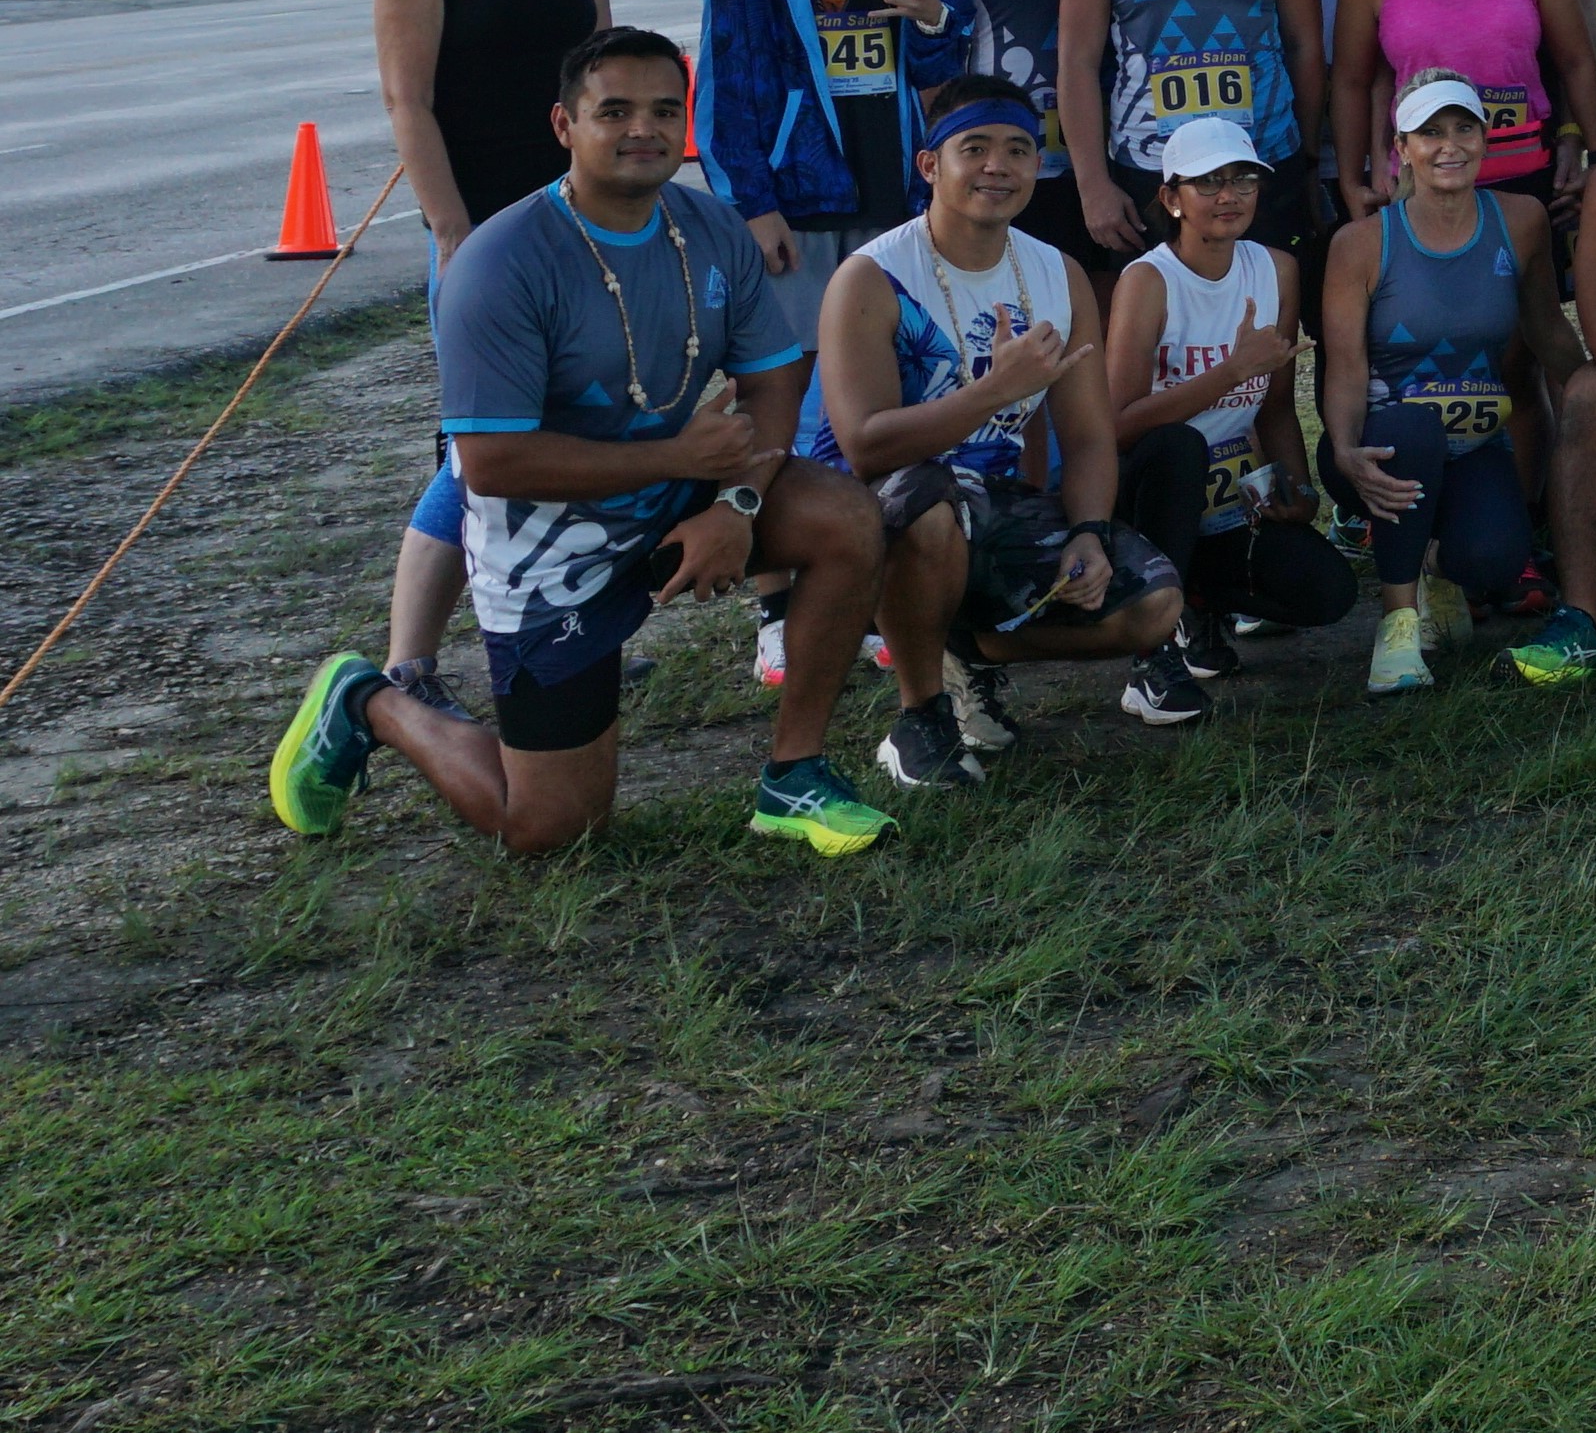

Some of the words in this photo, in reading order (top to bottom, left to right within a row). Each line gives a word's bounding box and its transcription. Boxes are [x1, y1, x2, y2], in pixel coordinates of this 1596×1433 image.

[1202, 51, 1247, 65] Saipan
[1161, 70, 1243, 110] 016
[1483, 88, 1525, 102] Saipan
[1420, 401, 1499, 435] 25
